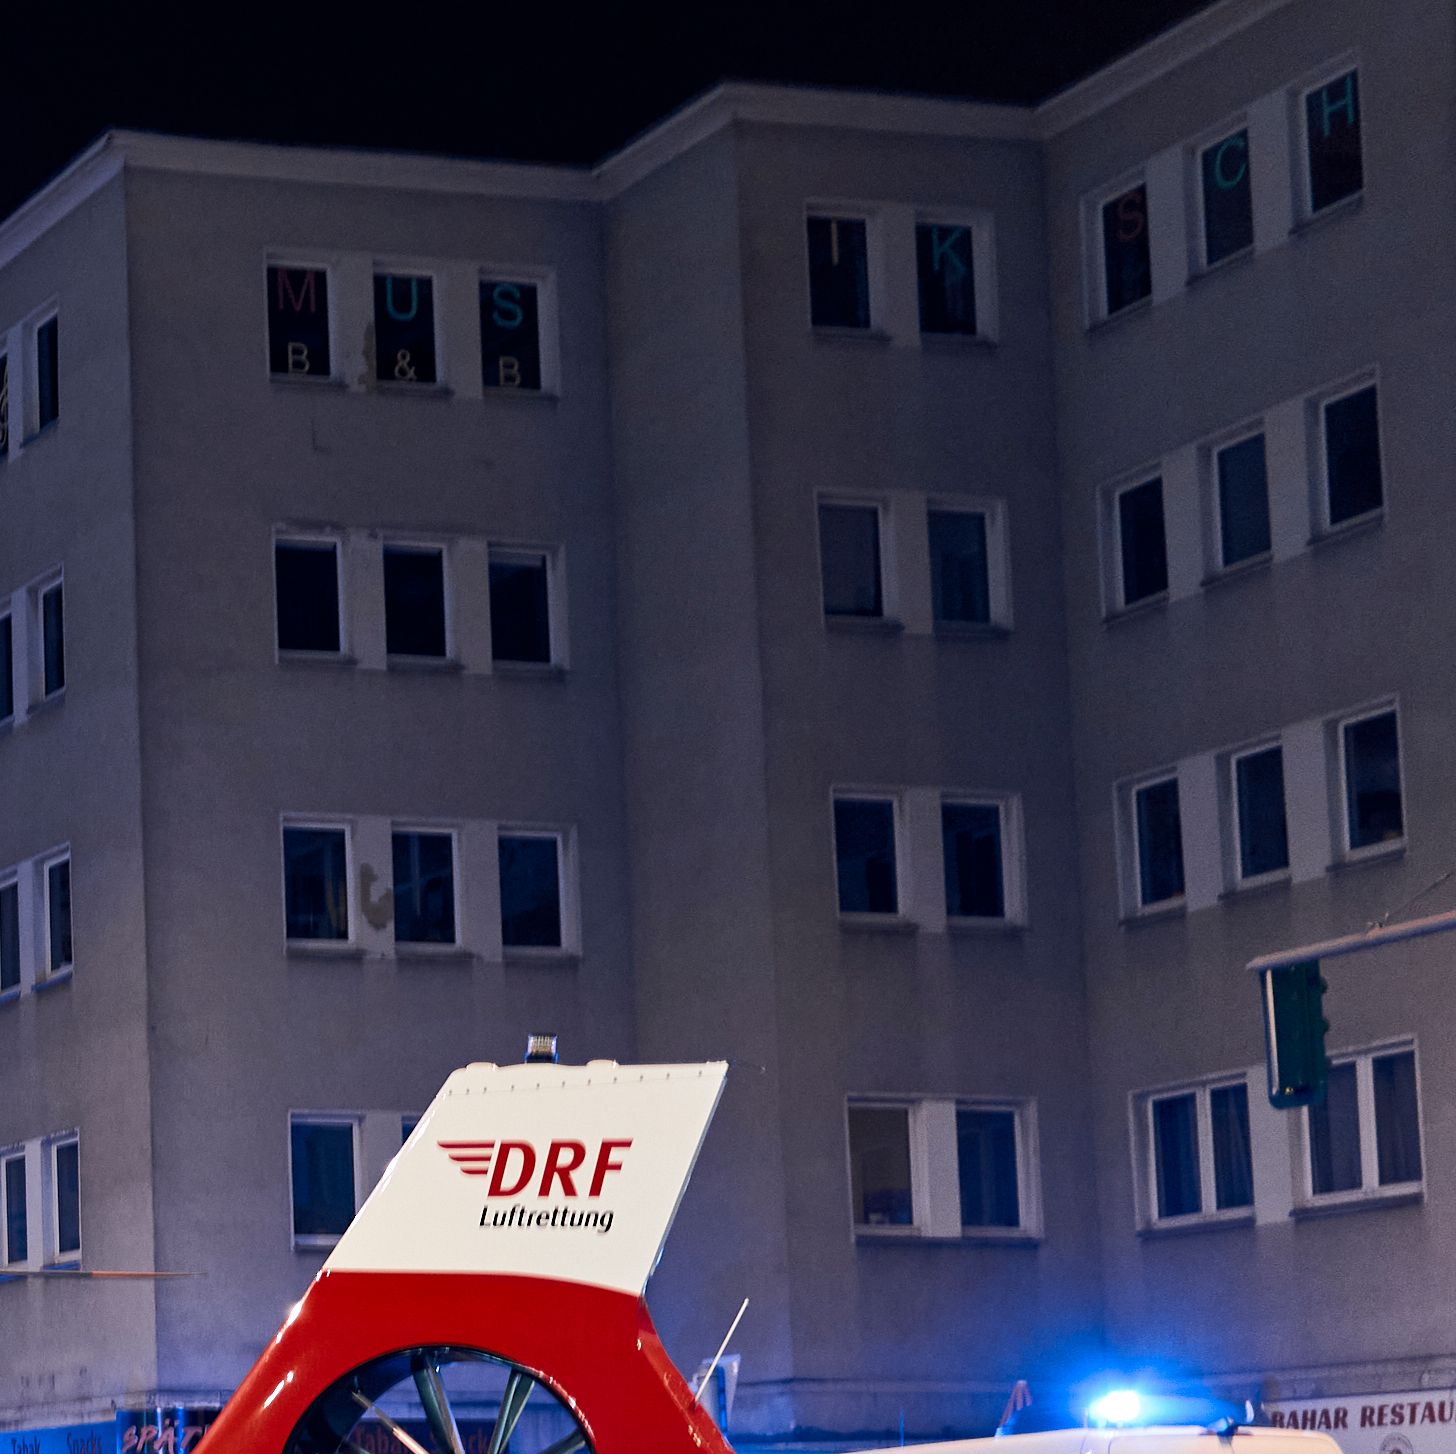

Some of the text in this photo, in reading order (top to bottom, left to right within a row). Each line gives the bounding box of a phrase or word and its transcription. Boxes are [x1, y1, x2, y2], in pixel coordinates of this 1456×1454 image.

[488, 1138, 633, 1198] DRF
[479, 1204, 615, 1236] Luftrettung
[1272, 1400, 1456, 1430] BAHAR RESTAU
